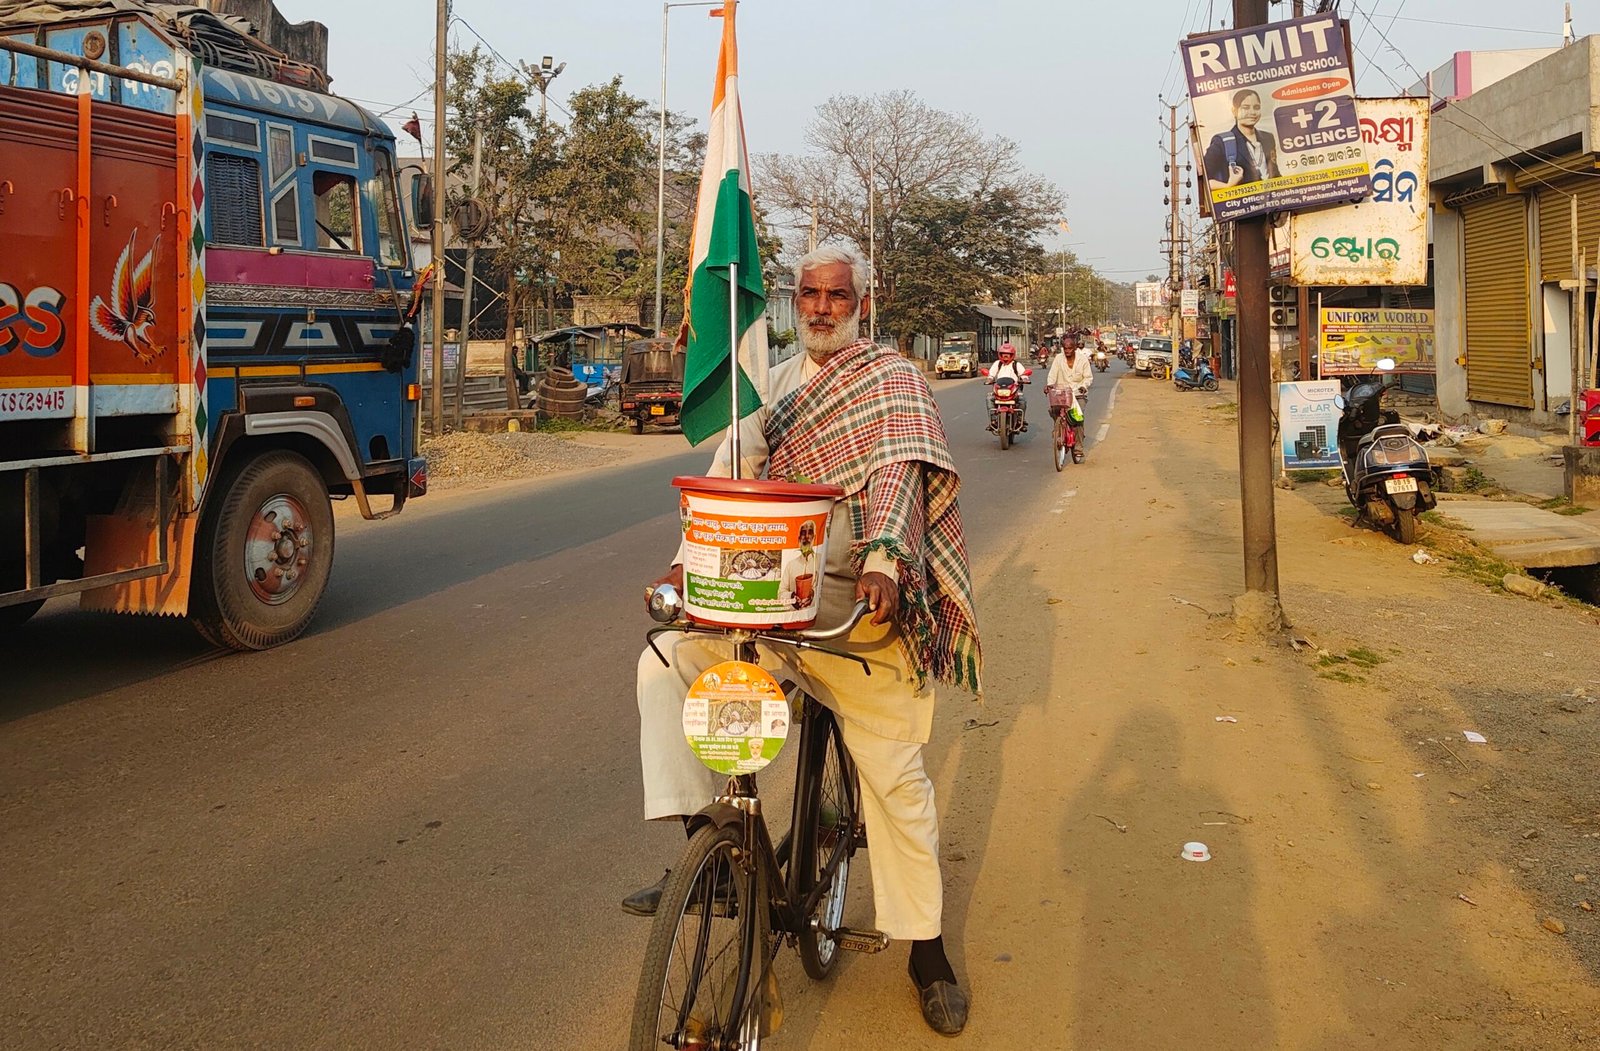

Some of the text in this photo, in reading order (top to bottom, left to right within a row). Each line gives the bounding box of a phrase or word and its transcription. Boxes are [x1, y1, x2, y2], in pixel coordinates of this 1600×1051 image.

[1188, 19, 1334, 78] RIMIT
[1196, 55, 1342, 93] HIGHER SECONDARY SCHOOL
[1281, 80, 1341, 97] Admissions Open
[1291, 100, 1341, 129] +2
[1282, 126, 1358, 150] SCIENCE
[1221, 209, 1246, 218] Campus
[1266, 200, 1280, 208] RTO
[1350, 185, 1368, 195] Angul
[1225, 199, 1241, 209] City
[1242, 194, 1265, 204] Office
[1337, 177, 1359, 188] Angul
[1326, 311, 1428, 324] UNIFORM WORLD
